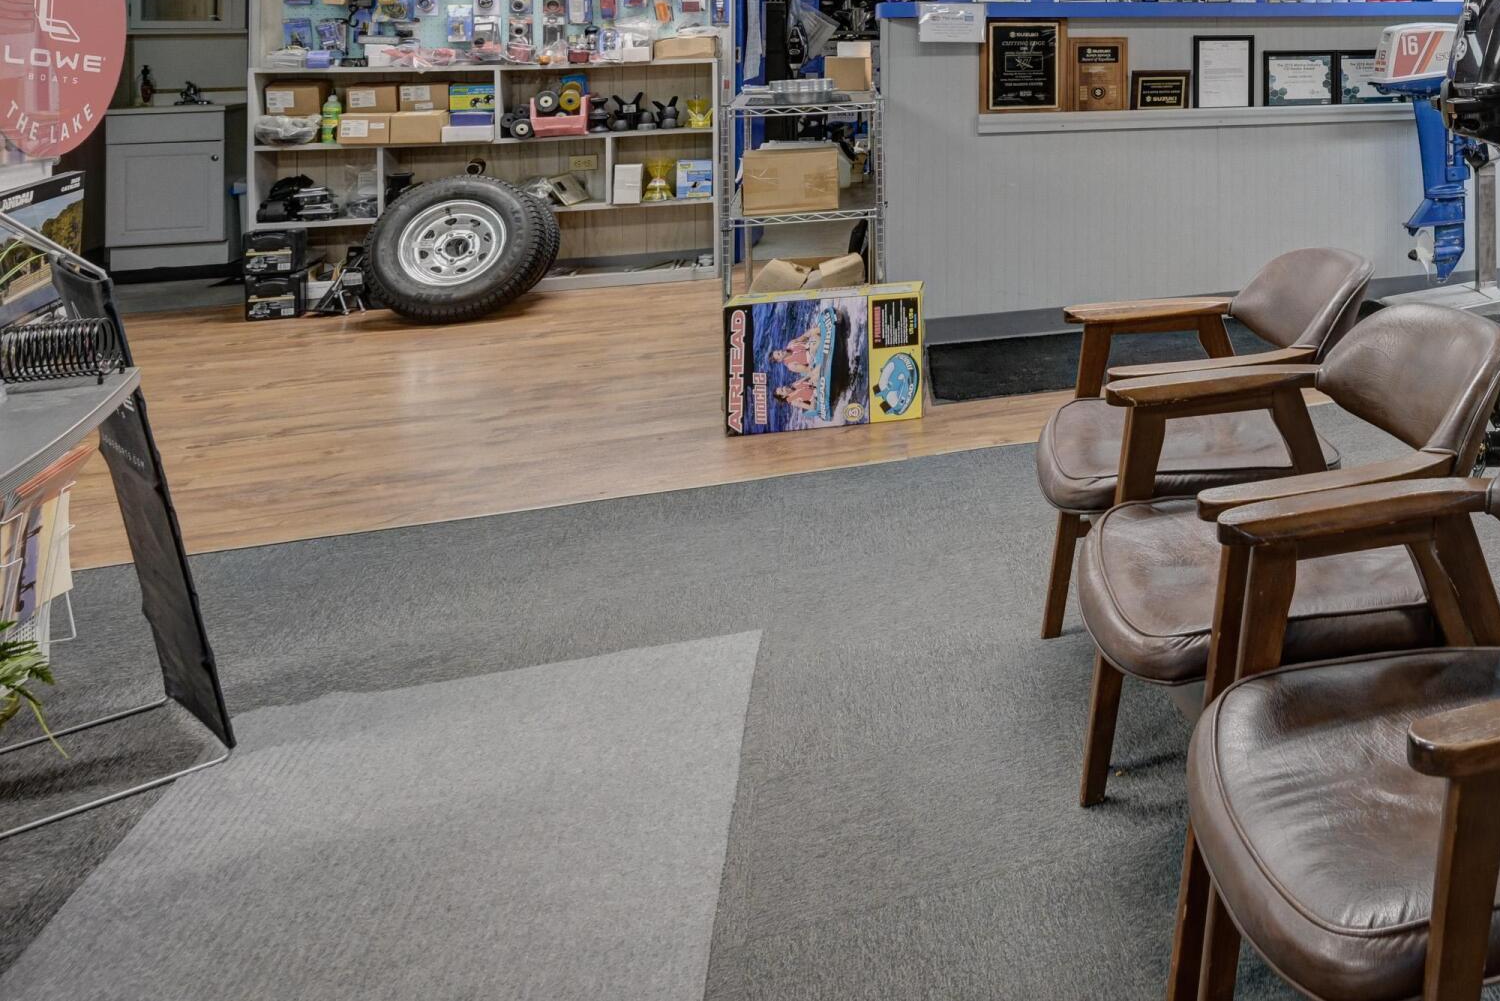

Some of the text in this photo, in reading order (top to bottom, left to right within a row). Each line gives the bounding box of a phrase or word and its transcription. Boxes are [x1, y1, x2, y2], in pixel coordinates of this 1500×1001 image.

[4, 45, 102, 73] LOWE
[1401, 35, 1419, 56] 16
[28, 73, 79, 85] BOATS
[5, 100, 94, 145] THE LAKE
[0, 190, 34, 212] ANDAU
[728, 309, 747, 433] AIRHEAD
[752, 372, 768, 425] mach 2
